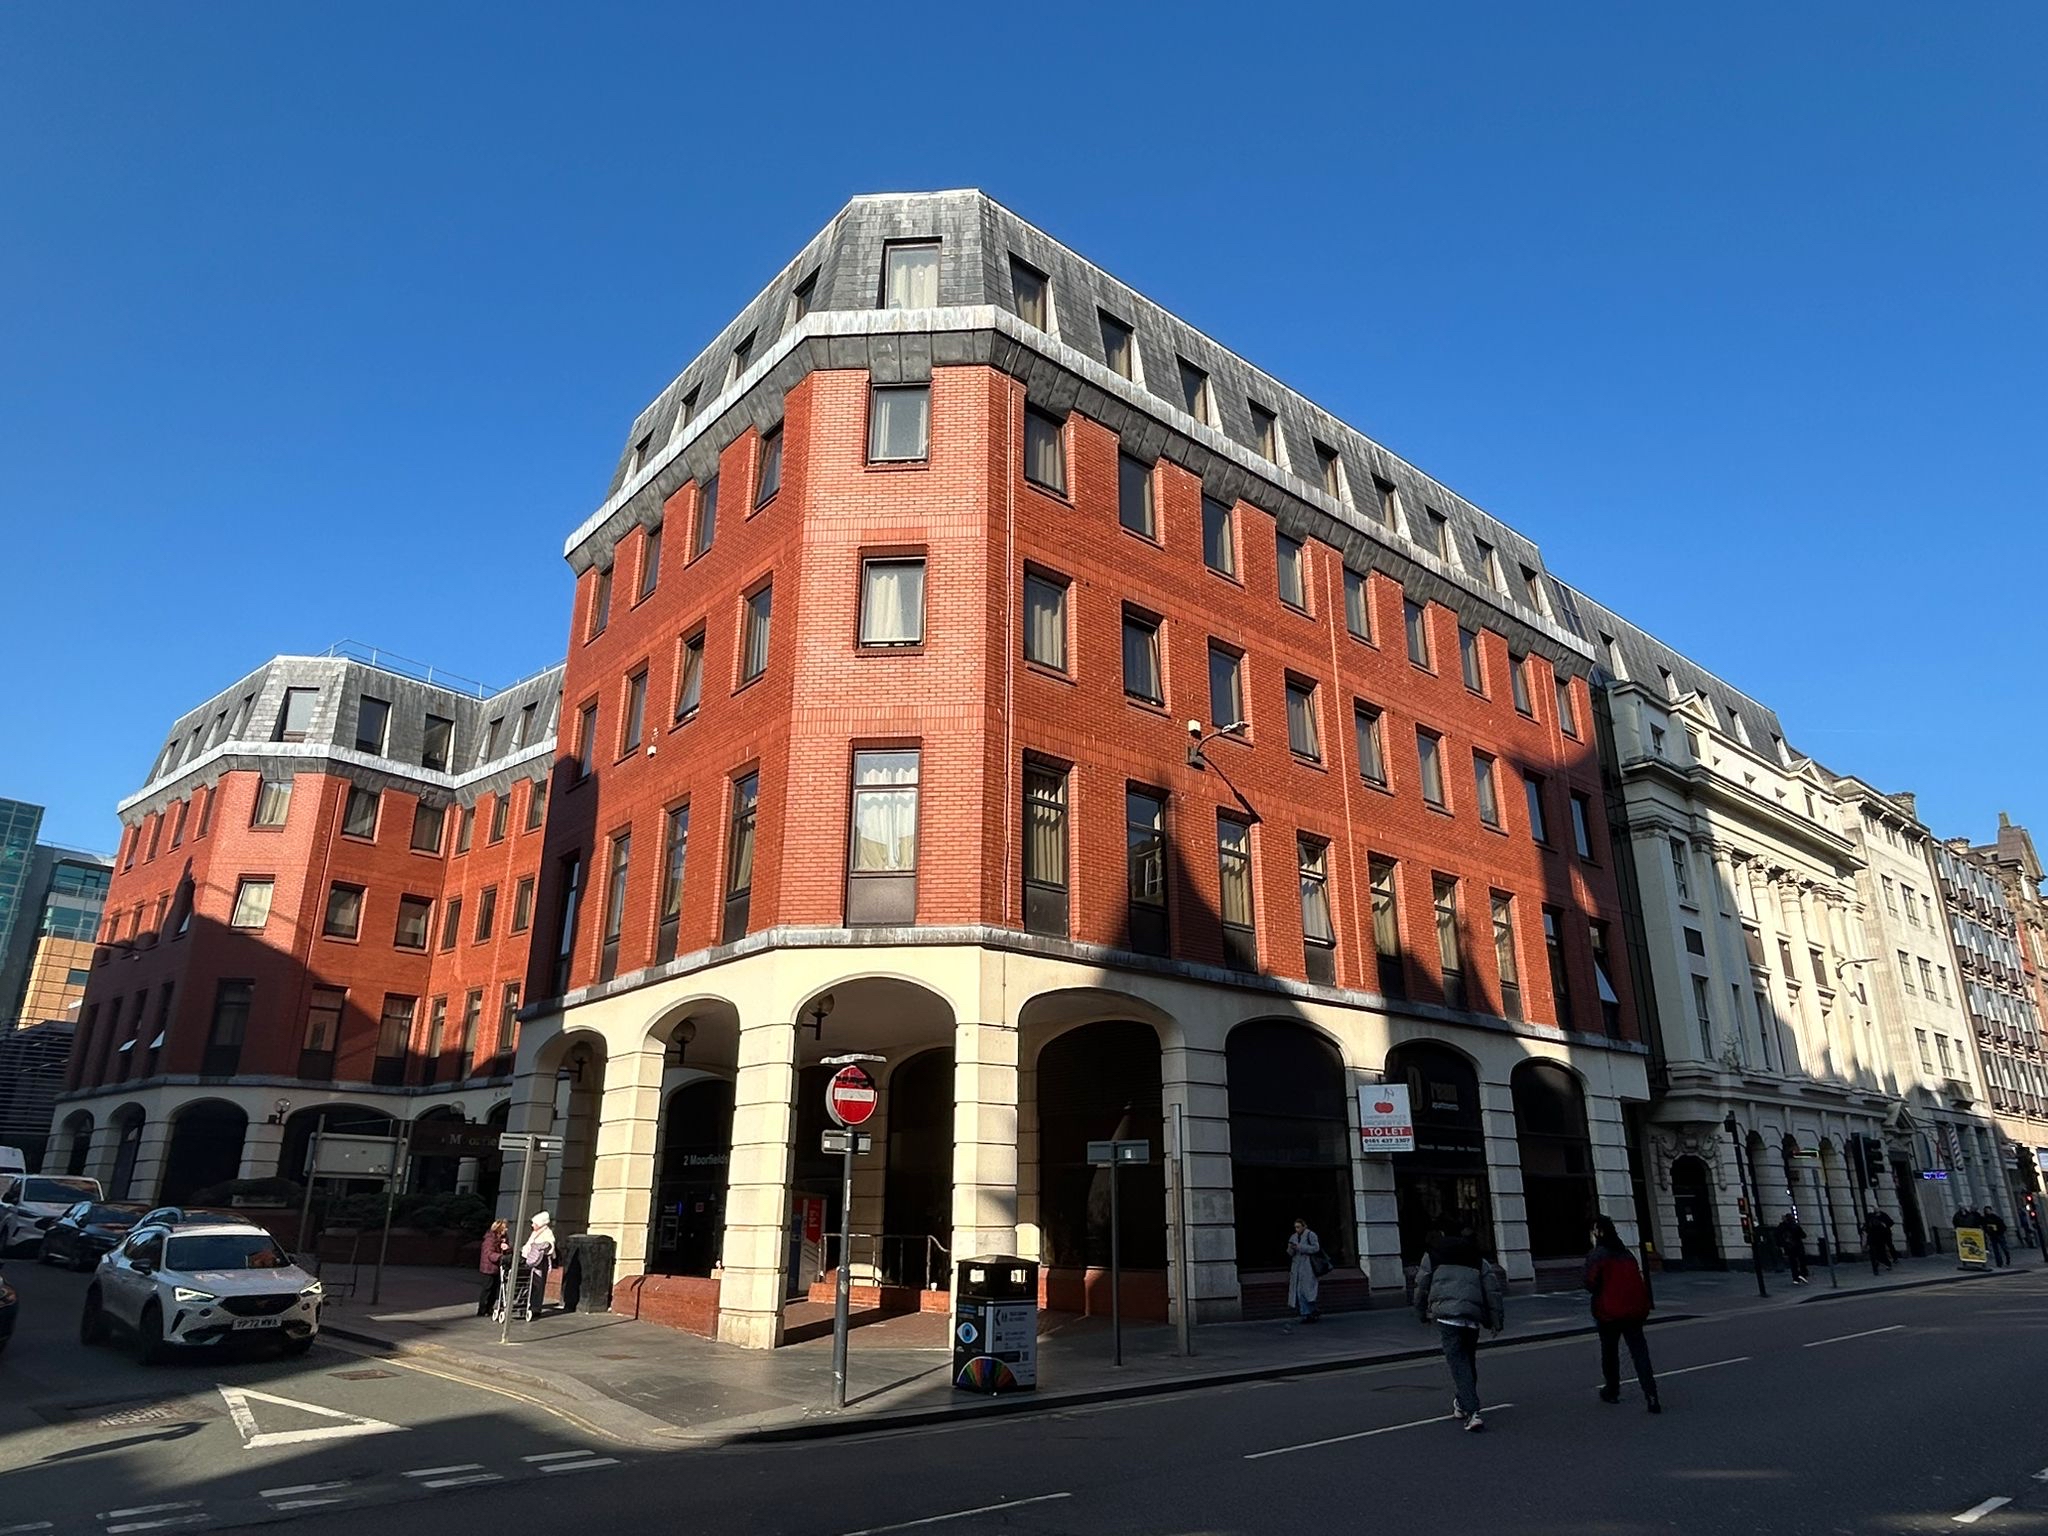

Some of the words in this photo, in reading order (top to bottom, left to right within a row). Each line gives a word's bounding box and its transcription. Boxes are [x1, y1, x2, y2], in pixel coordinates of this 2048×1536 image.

[1368, 1127, 1383, 1137] TO
[1385, 1127, 1405, 1136] LET
[683, 1155, 689, 1166] 2
